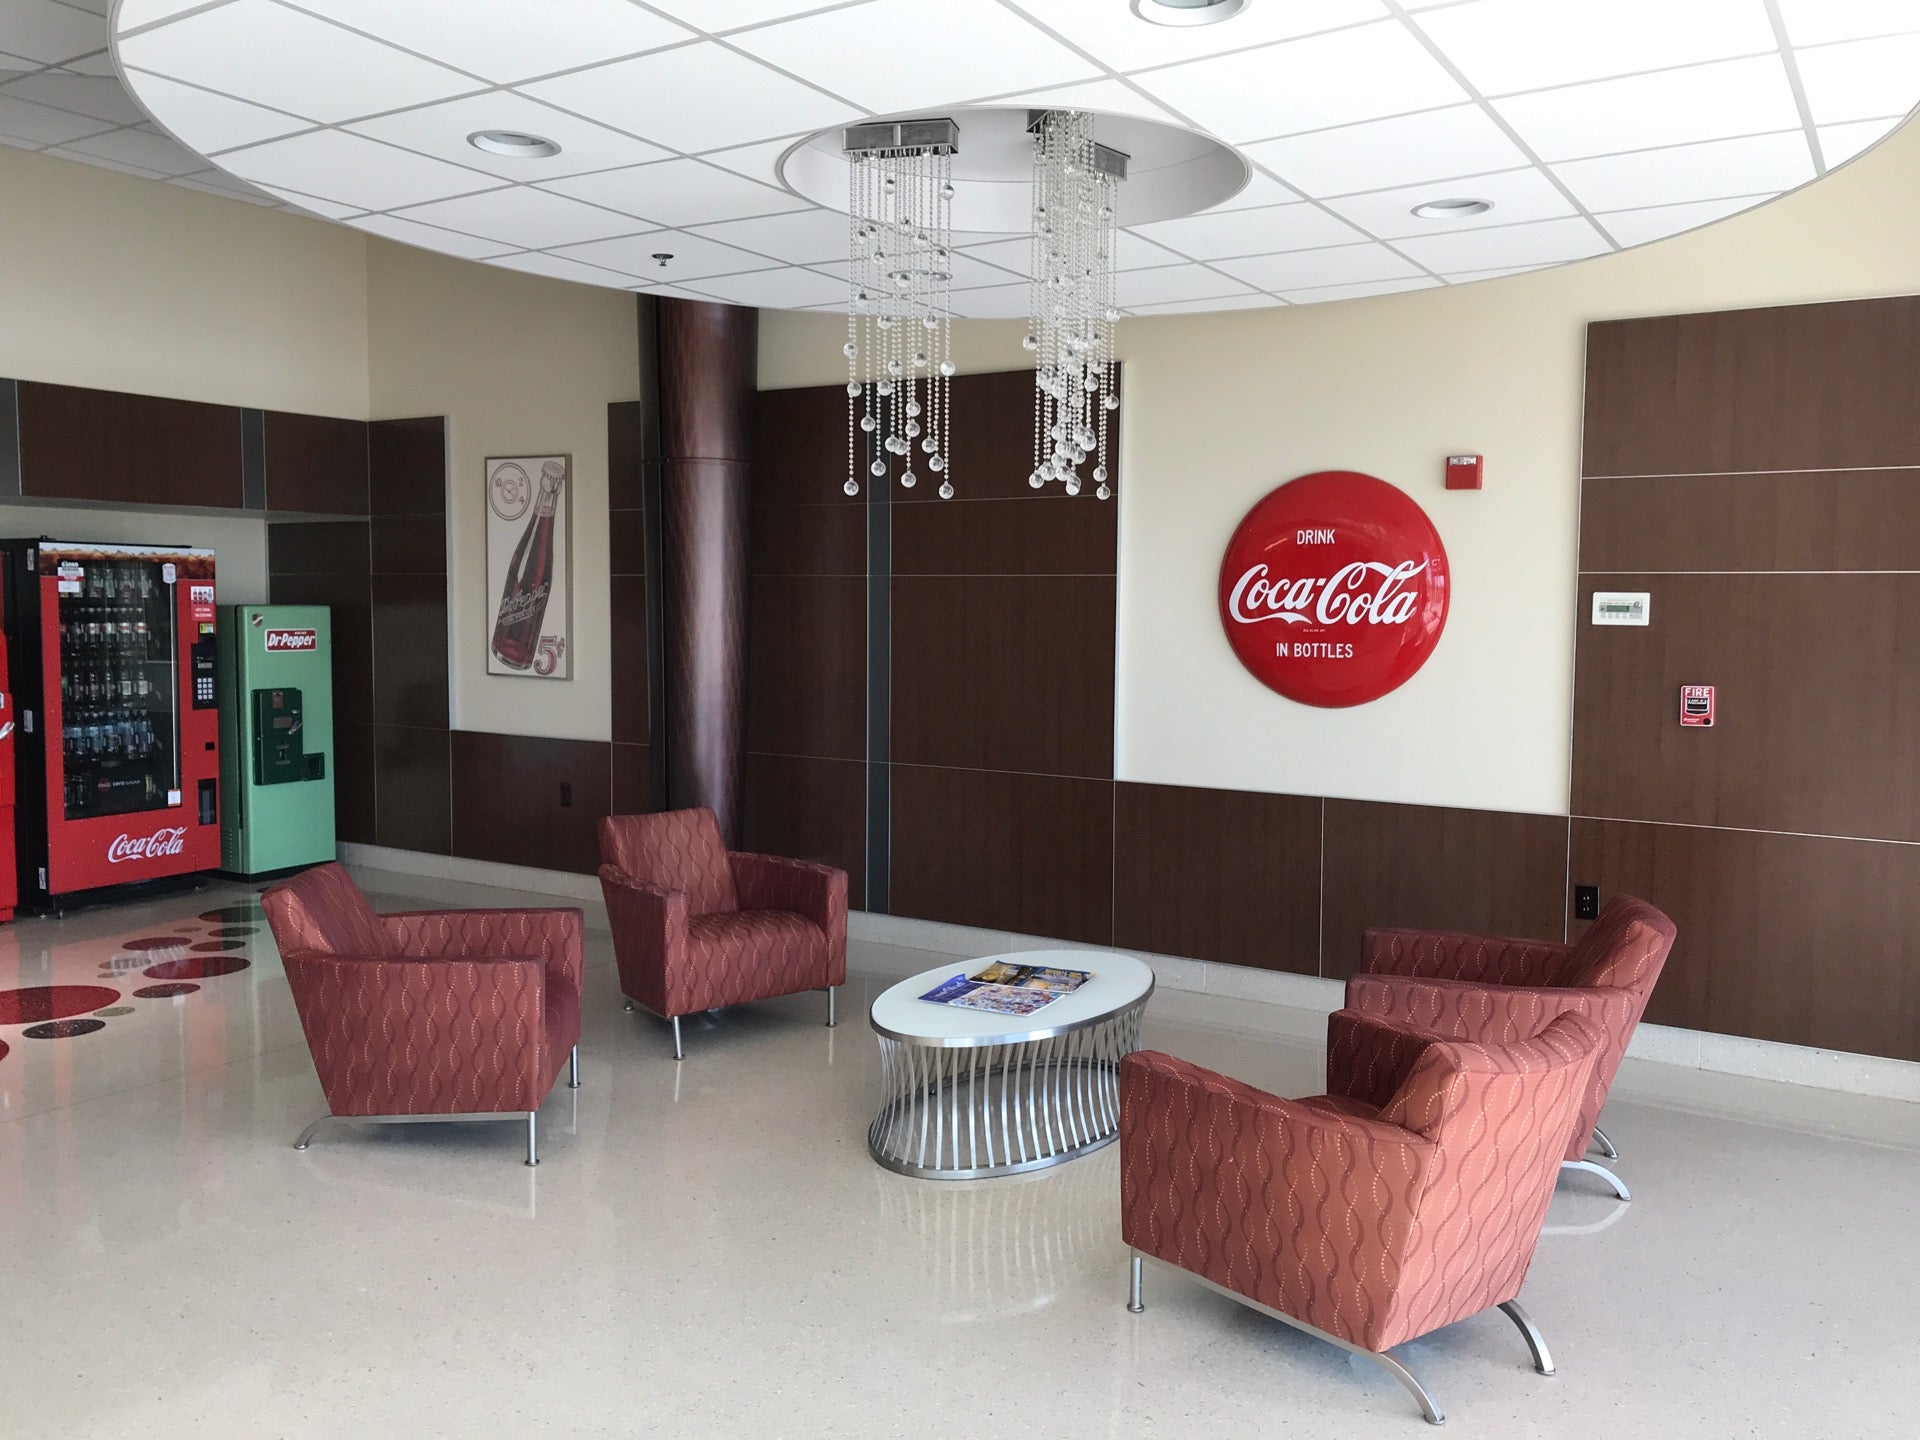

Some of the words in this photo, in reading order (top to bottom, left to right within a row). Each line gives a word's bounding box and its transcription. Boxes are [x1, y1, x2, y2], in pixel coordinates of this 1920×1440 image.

[519, 476, 525, 487] 2
[518, 495, 525, 505] 4
[1296, 528, 1336, 545] DRINK
[1228, 559, 1430, 625] Coca-Cola
[1276, 642, 1289, 657] IN
[1293, 643, 1354, 659] BOTTLES
[1685, 687, 1710, 697] FIRE
[108, 826, 187, 863] Coca-Cola
